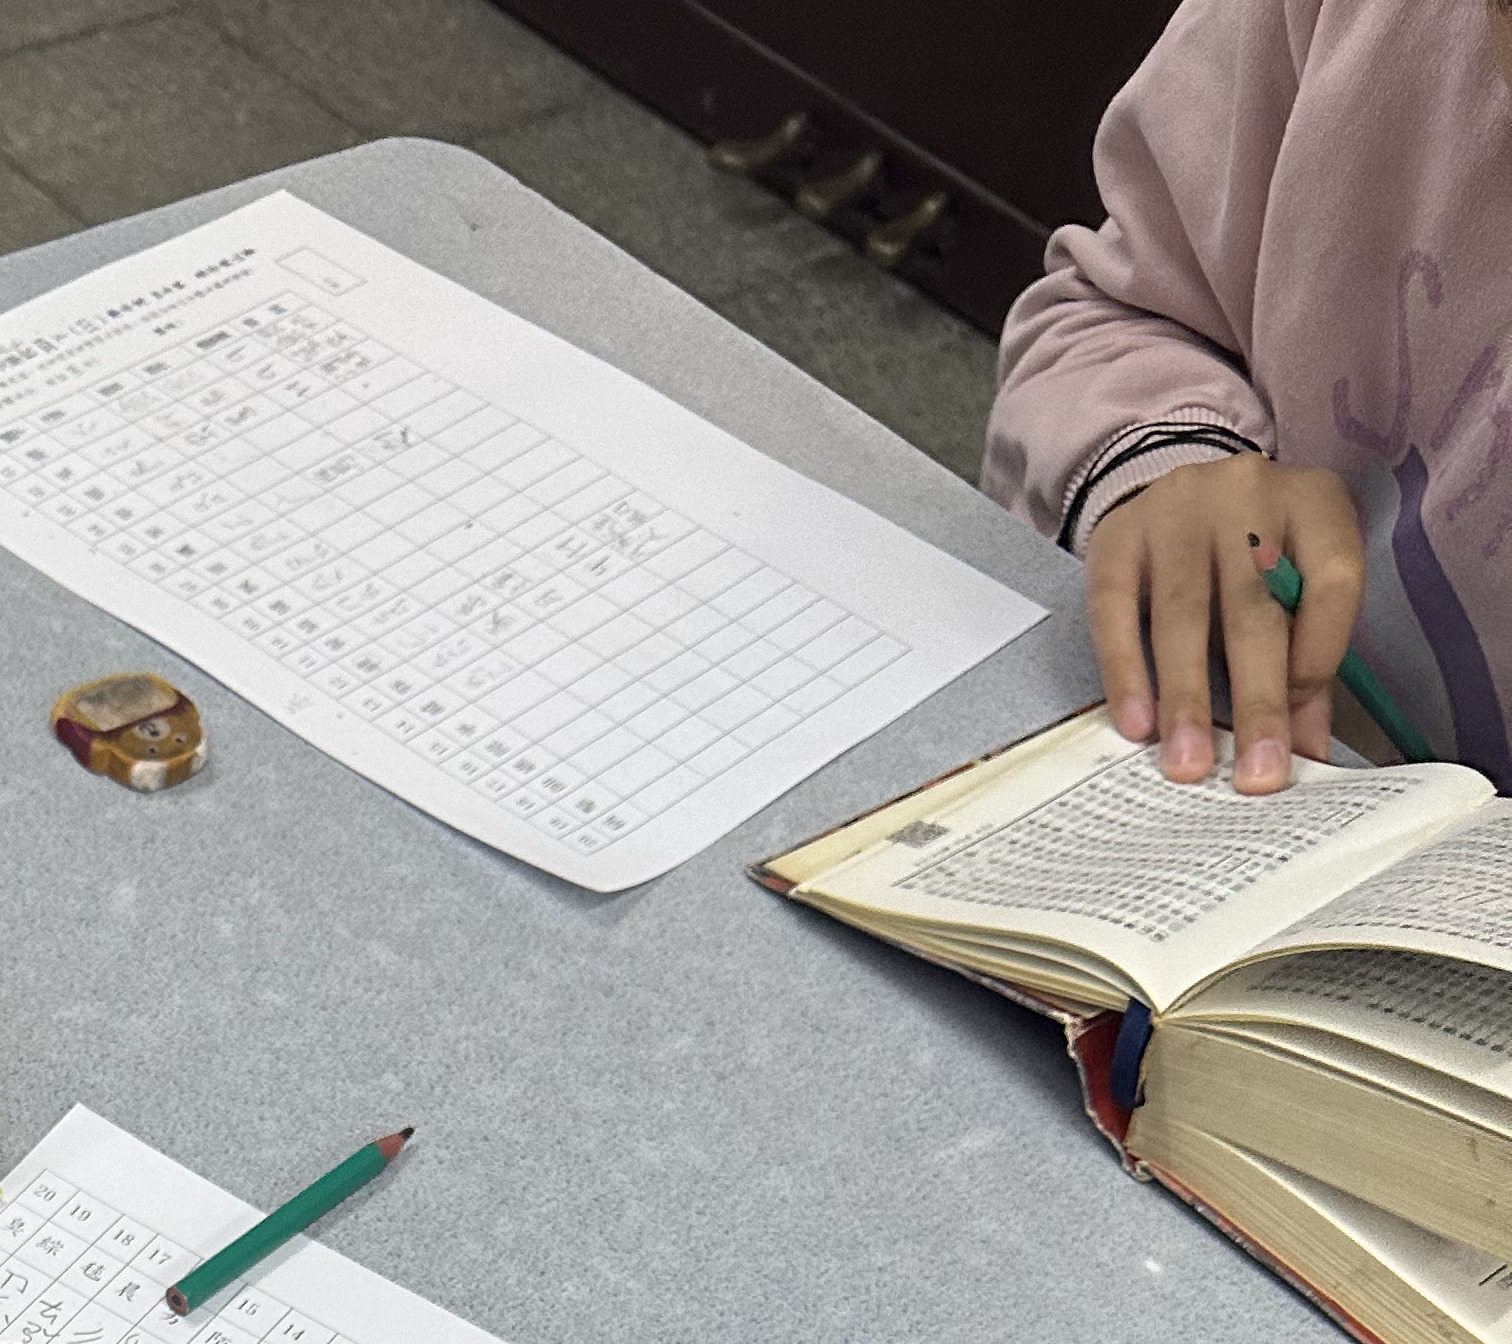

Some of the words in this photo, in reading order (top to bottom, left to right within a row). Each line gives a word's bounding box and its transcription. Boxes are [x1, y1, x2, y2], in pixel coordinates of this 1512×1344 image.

[32, 1183, 58, 1203] 20
[69, 1204, 93, 1223] 19
[6, 1217, 26, 1239] 臭
[112, 1228, 137, 1247] 18
[34, 1235, 66, 1258] 綜
[147, 1248, 173, 1266] 17
[82, 1261, 106, 1283] 毯
[117, 1280, 142, 1303] 晨
[236, 1298, 258, 1317] 15
[282, 1323, 306, 1342] 14
